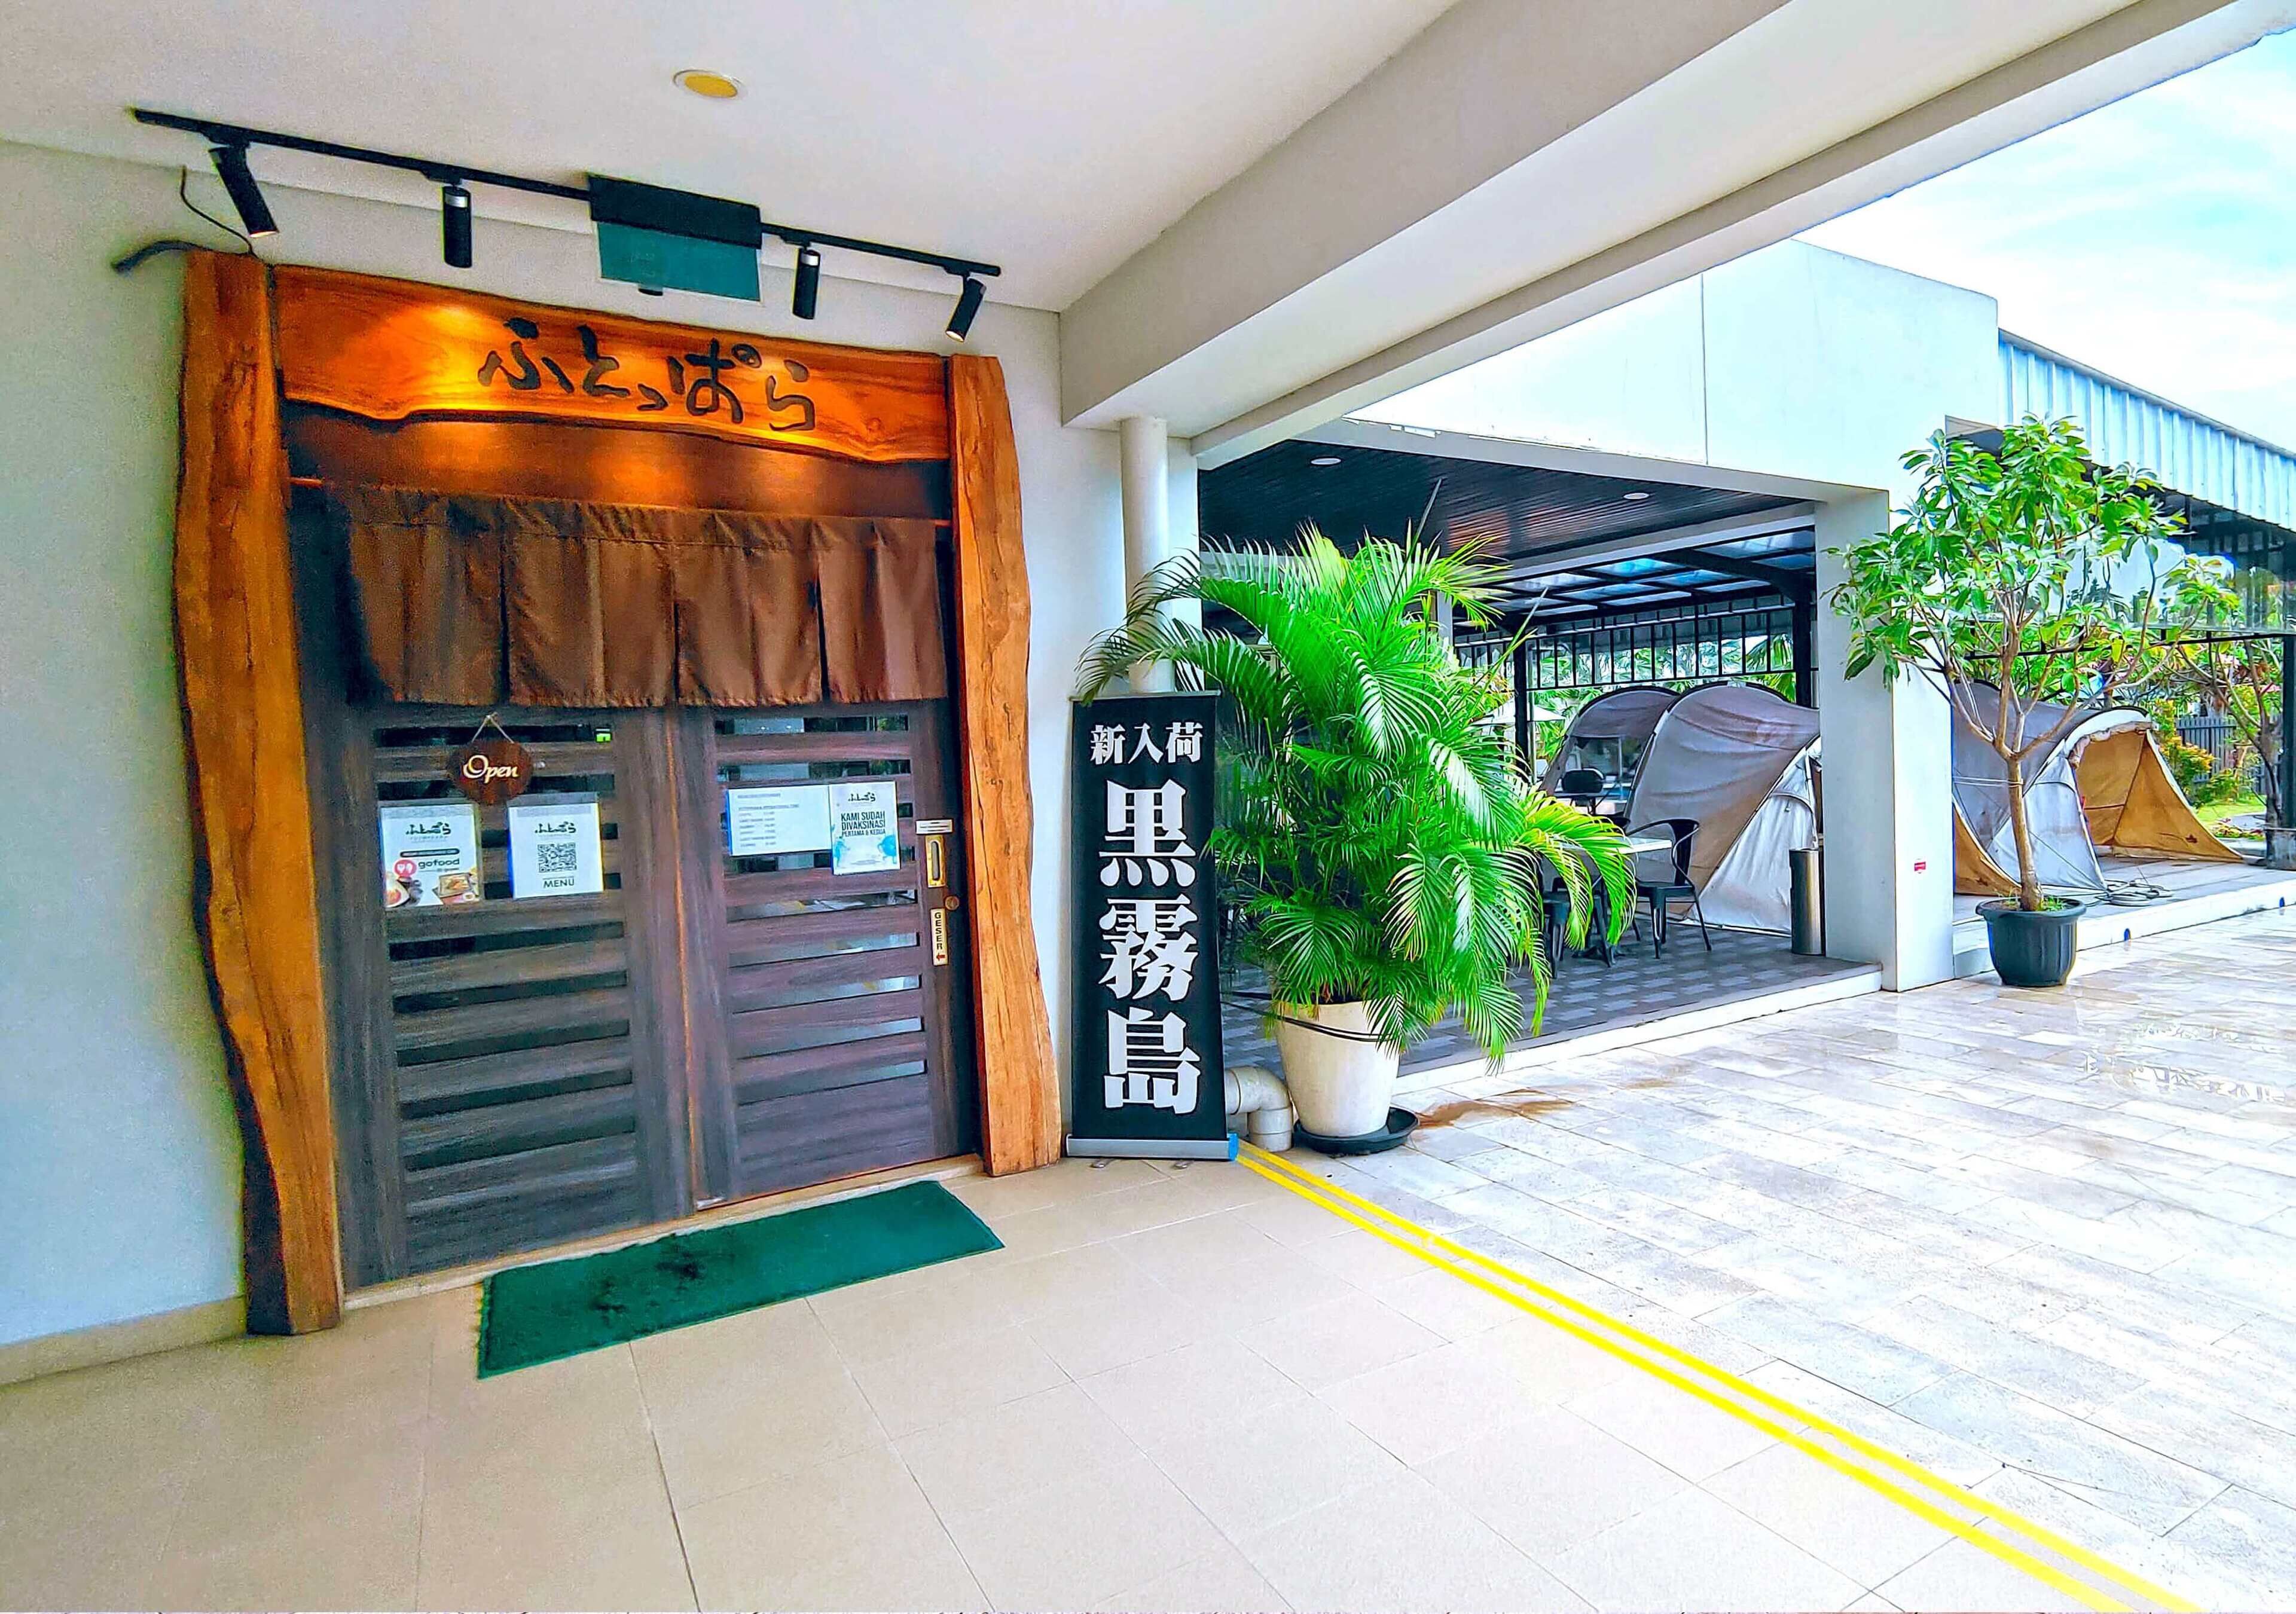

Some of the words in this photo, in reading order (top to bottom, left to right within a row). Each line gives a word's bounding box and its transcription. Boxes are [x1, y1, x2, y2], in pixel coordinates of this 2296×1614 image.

[478, 317, 816, 431] ふとっぱら
[1090, 722, 1202, 765] 新入荷
[463, 754, 520, 784] Open
[841, 812, 860, 821] KAMI
[861, 811, 886, 821] SUDAH
[841, 820, 886, 830] DIVAKSINASI
[418, 858, 460, 869] gofood
[544, 878, 575, 888] MENU
[934, 912, 943, 950] GESER
[1098, 778, 1201, 1114] 黒霧島
